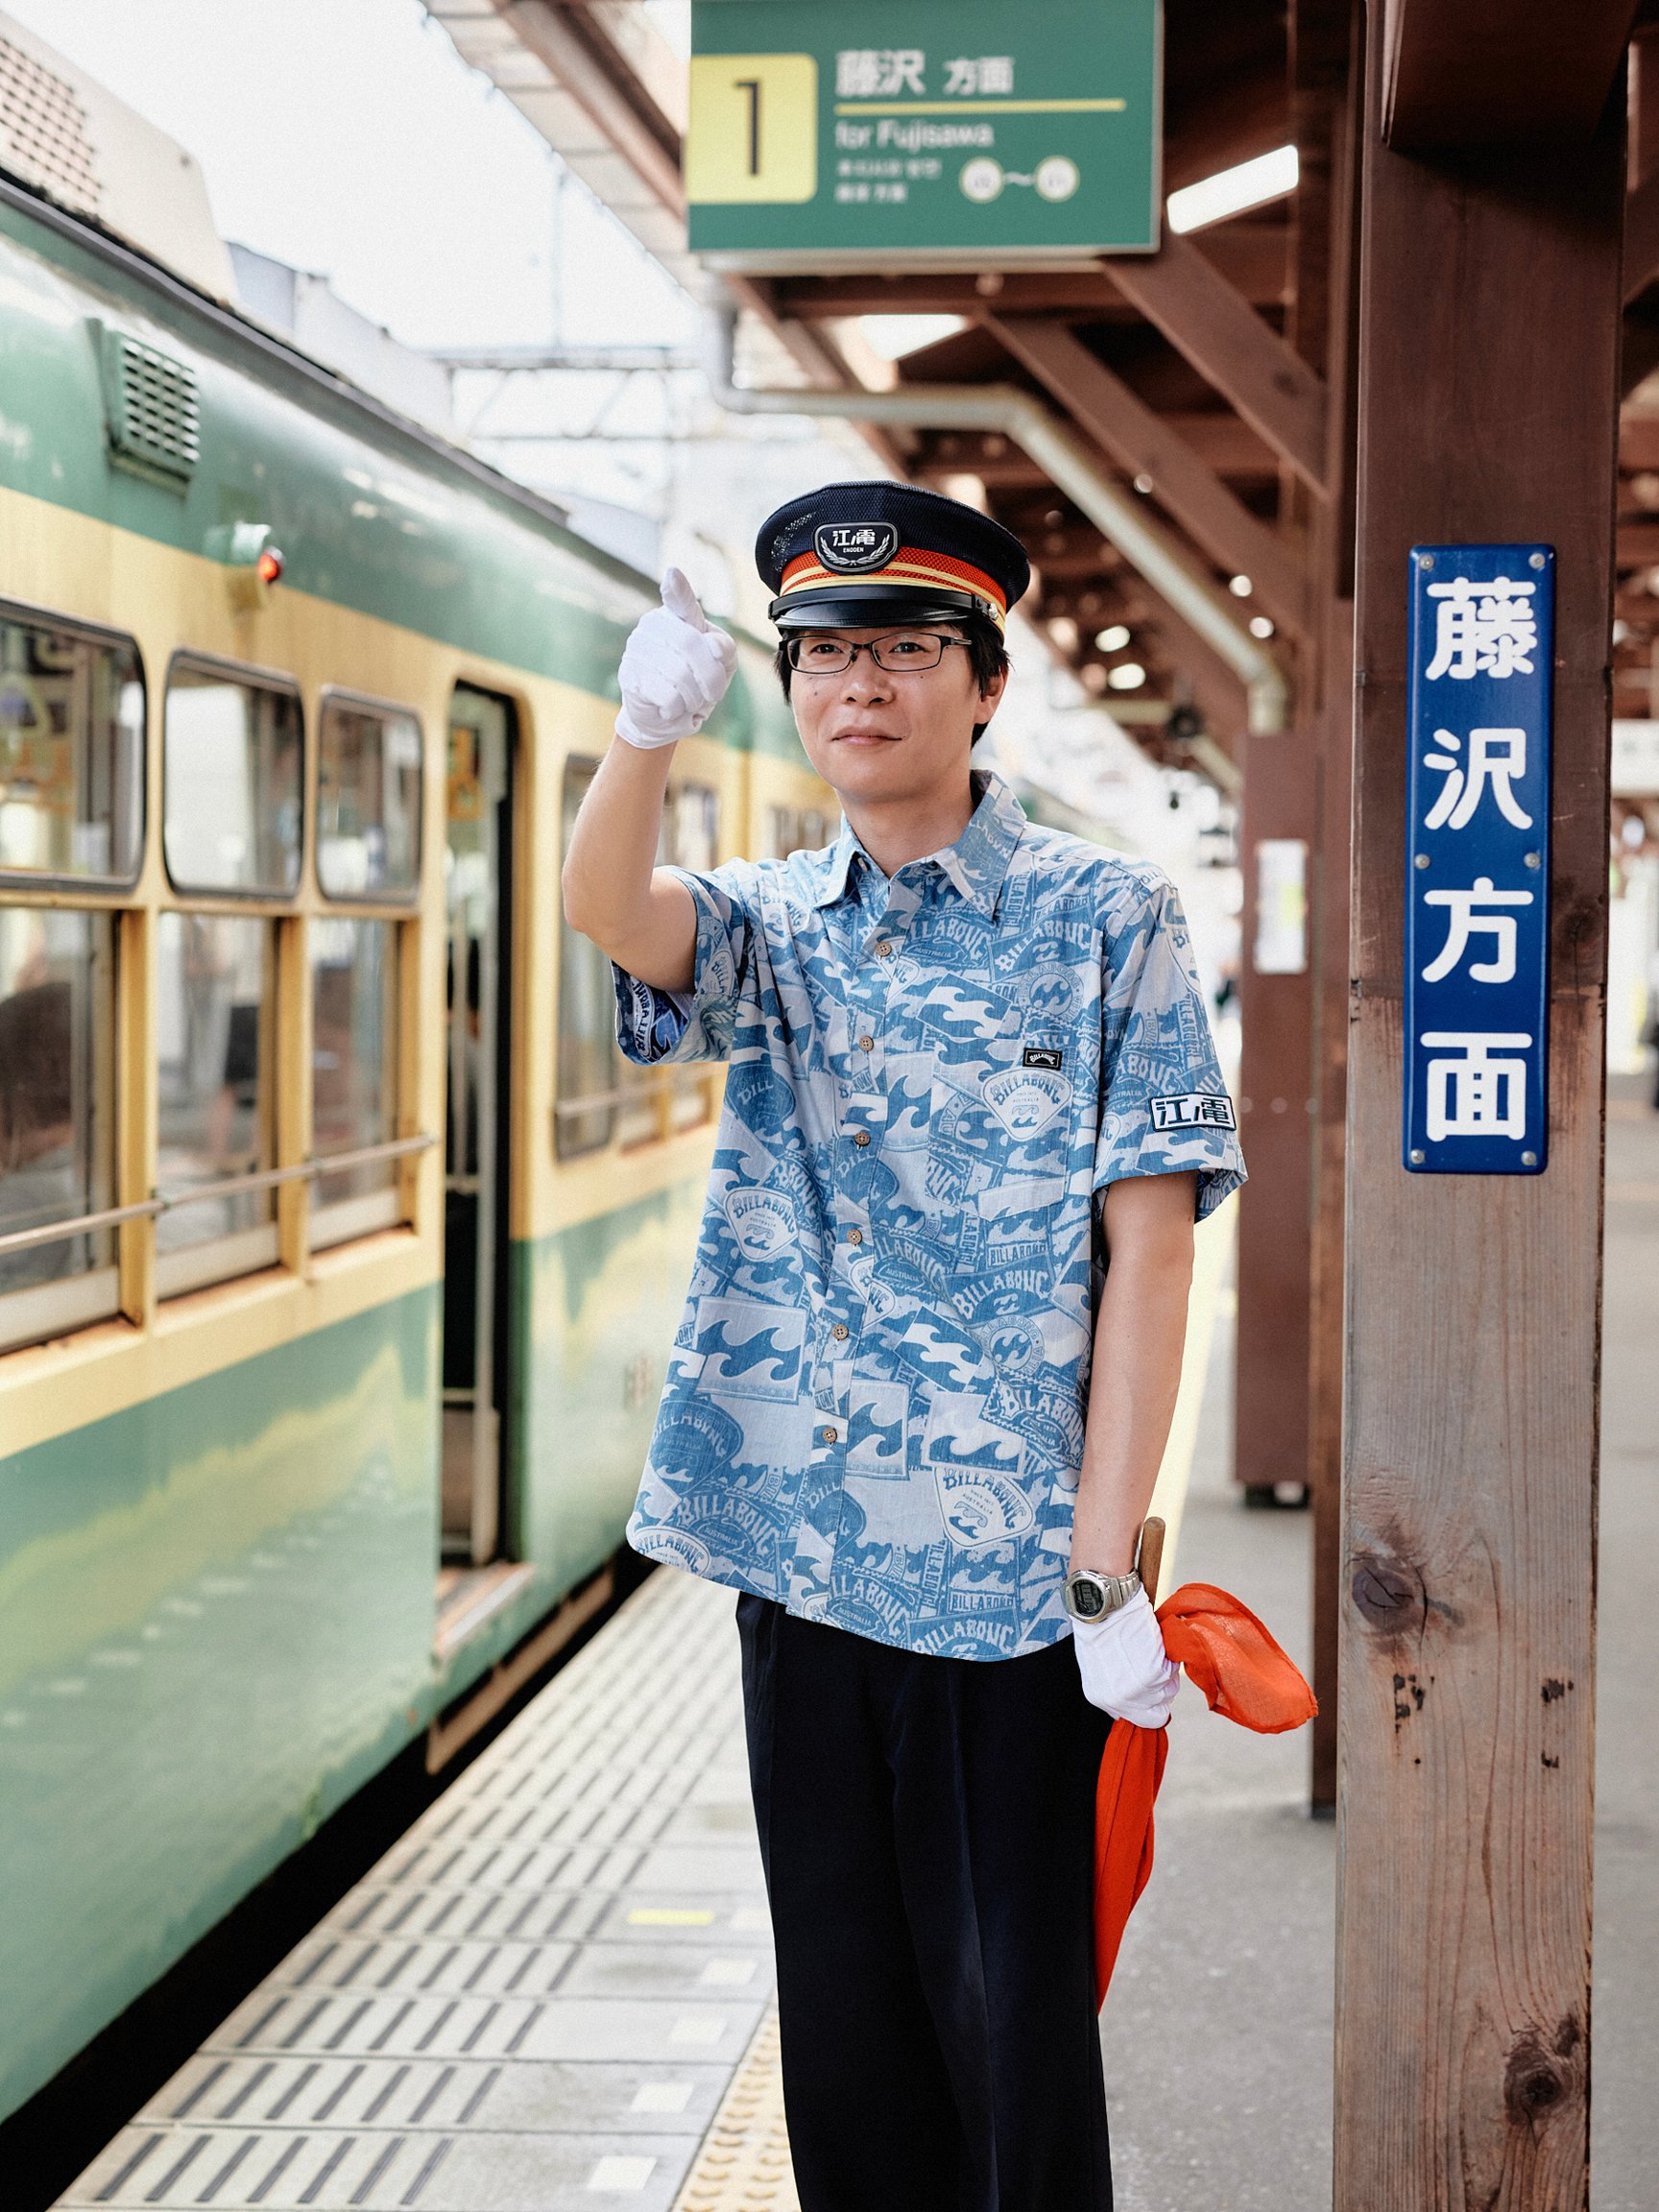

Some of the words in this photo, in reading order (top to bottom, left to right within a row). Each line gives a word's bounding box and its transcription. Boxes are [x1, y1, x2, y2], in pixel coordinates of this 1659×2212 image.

[834, 49, 927, 97] 藤沢
[943, 57, 1015, 95] 方面
[733, 78, 761, 178] 1
[834, 121, 874, 149] for
[877, 118, 996, 155] Fujisawa
[1421, 576, 1538, 1143] 藤沢方面
[994, 919, 1092, 973] BILLABONG
[1028, 1052, 1056, 1065] BILLABONG
[991, 1072, 1067, 1106] BILLABONG
[952, 1270, 1052, 1320] BILLABONG
[943, 1468, 1026, 1529] BILLABONG
[678, 1495, 781, 1555] BILLABONG
[704, 1526, 738, 1546] AUSTRALIA
